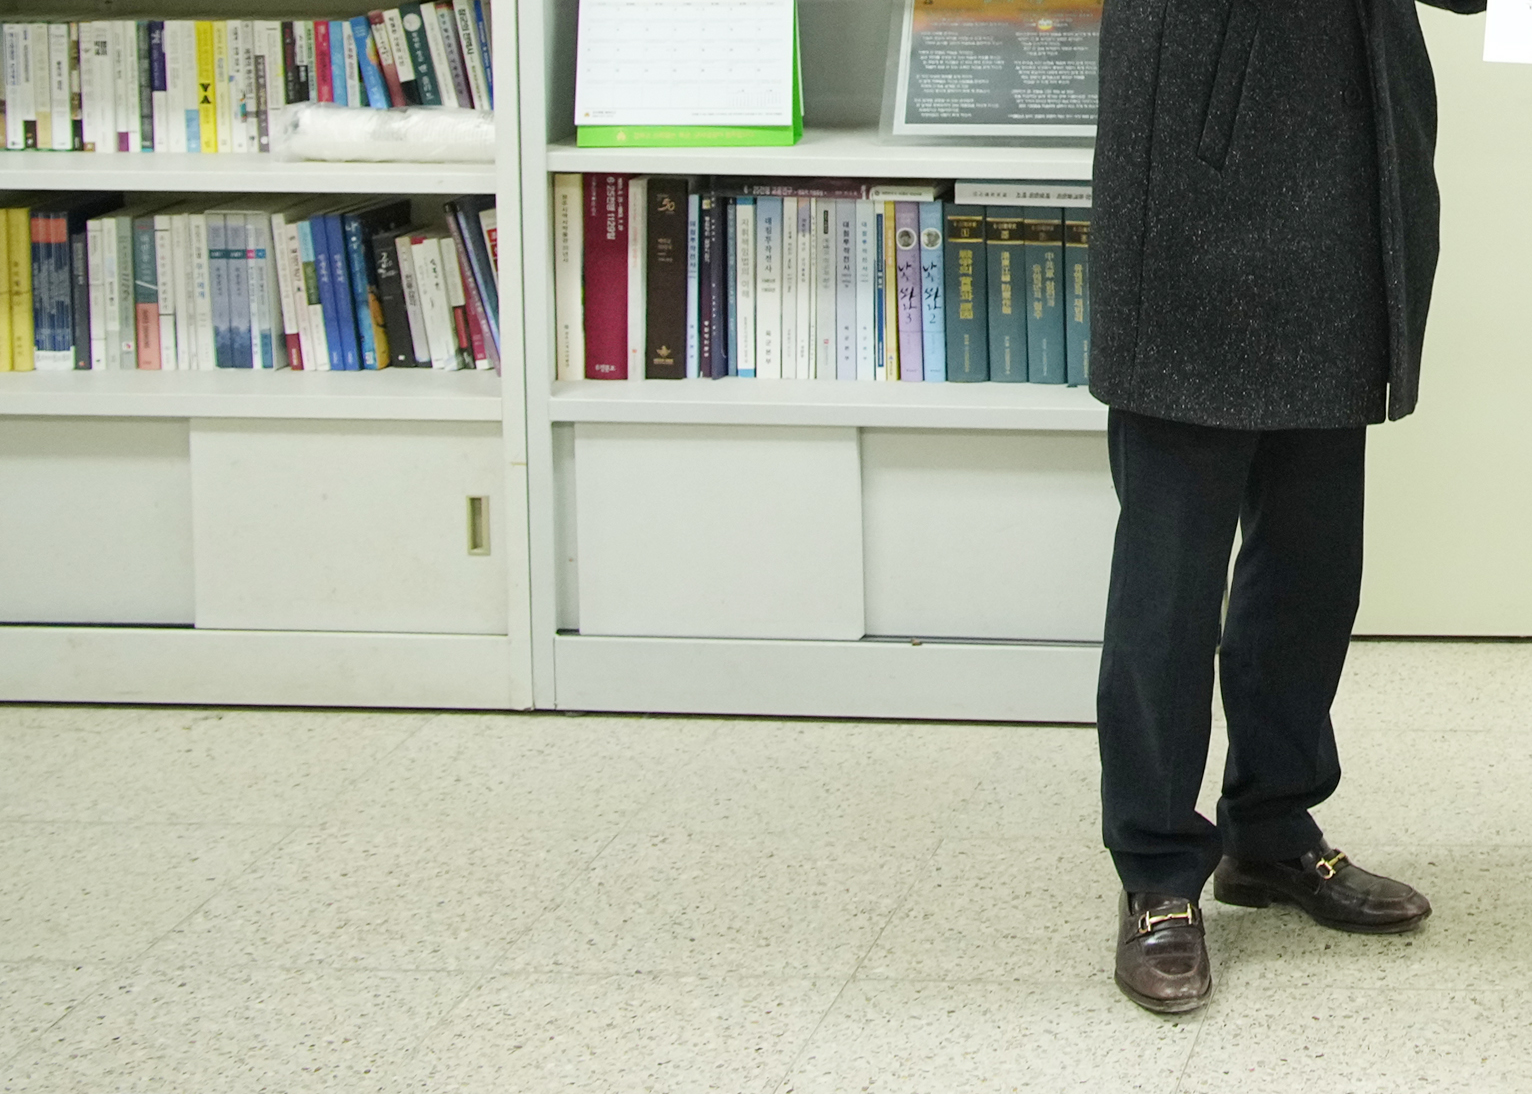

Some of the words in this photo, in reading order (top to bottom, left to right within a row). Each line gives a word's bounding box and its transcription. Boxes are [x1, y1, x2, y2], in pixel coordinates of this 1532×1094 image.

[606, 213, 616, 240] 1129일
[764, 217, 772, 273] 대침투작전사
[842, 221, 850, 271] 대침투작전사
[930, 313, 936, 324] 2
